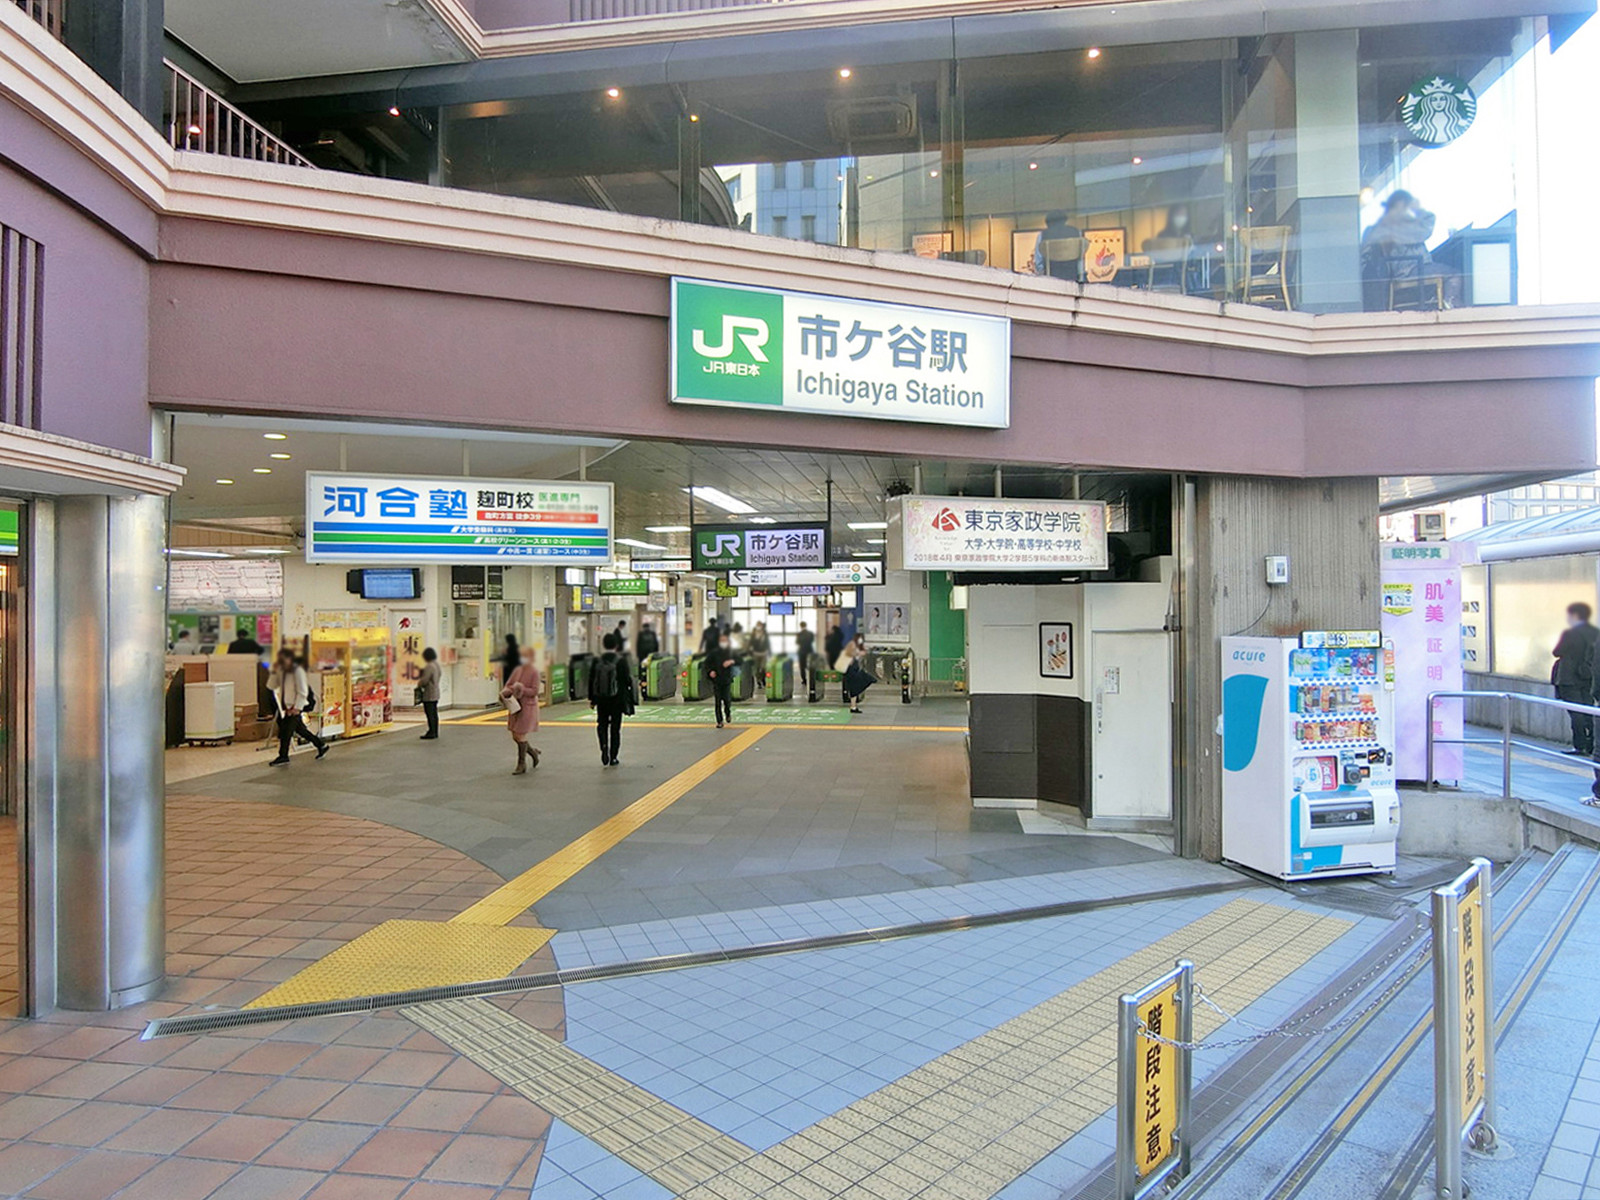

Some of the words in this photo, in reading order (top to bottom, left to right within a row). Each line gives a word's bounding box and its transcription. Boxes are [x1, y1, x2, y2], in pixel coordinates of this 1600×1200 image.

[692, 314, 769, 363] JR
[702, 362, 761, 378] JR東日本
[796, 369, 897, 405] Ichigaya
[905, 379, 985, 409] Station
[324, 486, 468, 519] 河合塾
[964, 509, 1081, 533] 東京家政学院
[701, 534, 741, 557] JR
[1391, 547, 1442, 559] 証明写真
[750, 554, 786, 565] Ichigaya
[788, 552, 819, 562] Station
[1232, 650, 1266, 662] acure
[1145, 1003, 1163, 1165] 階段注意
